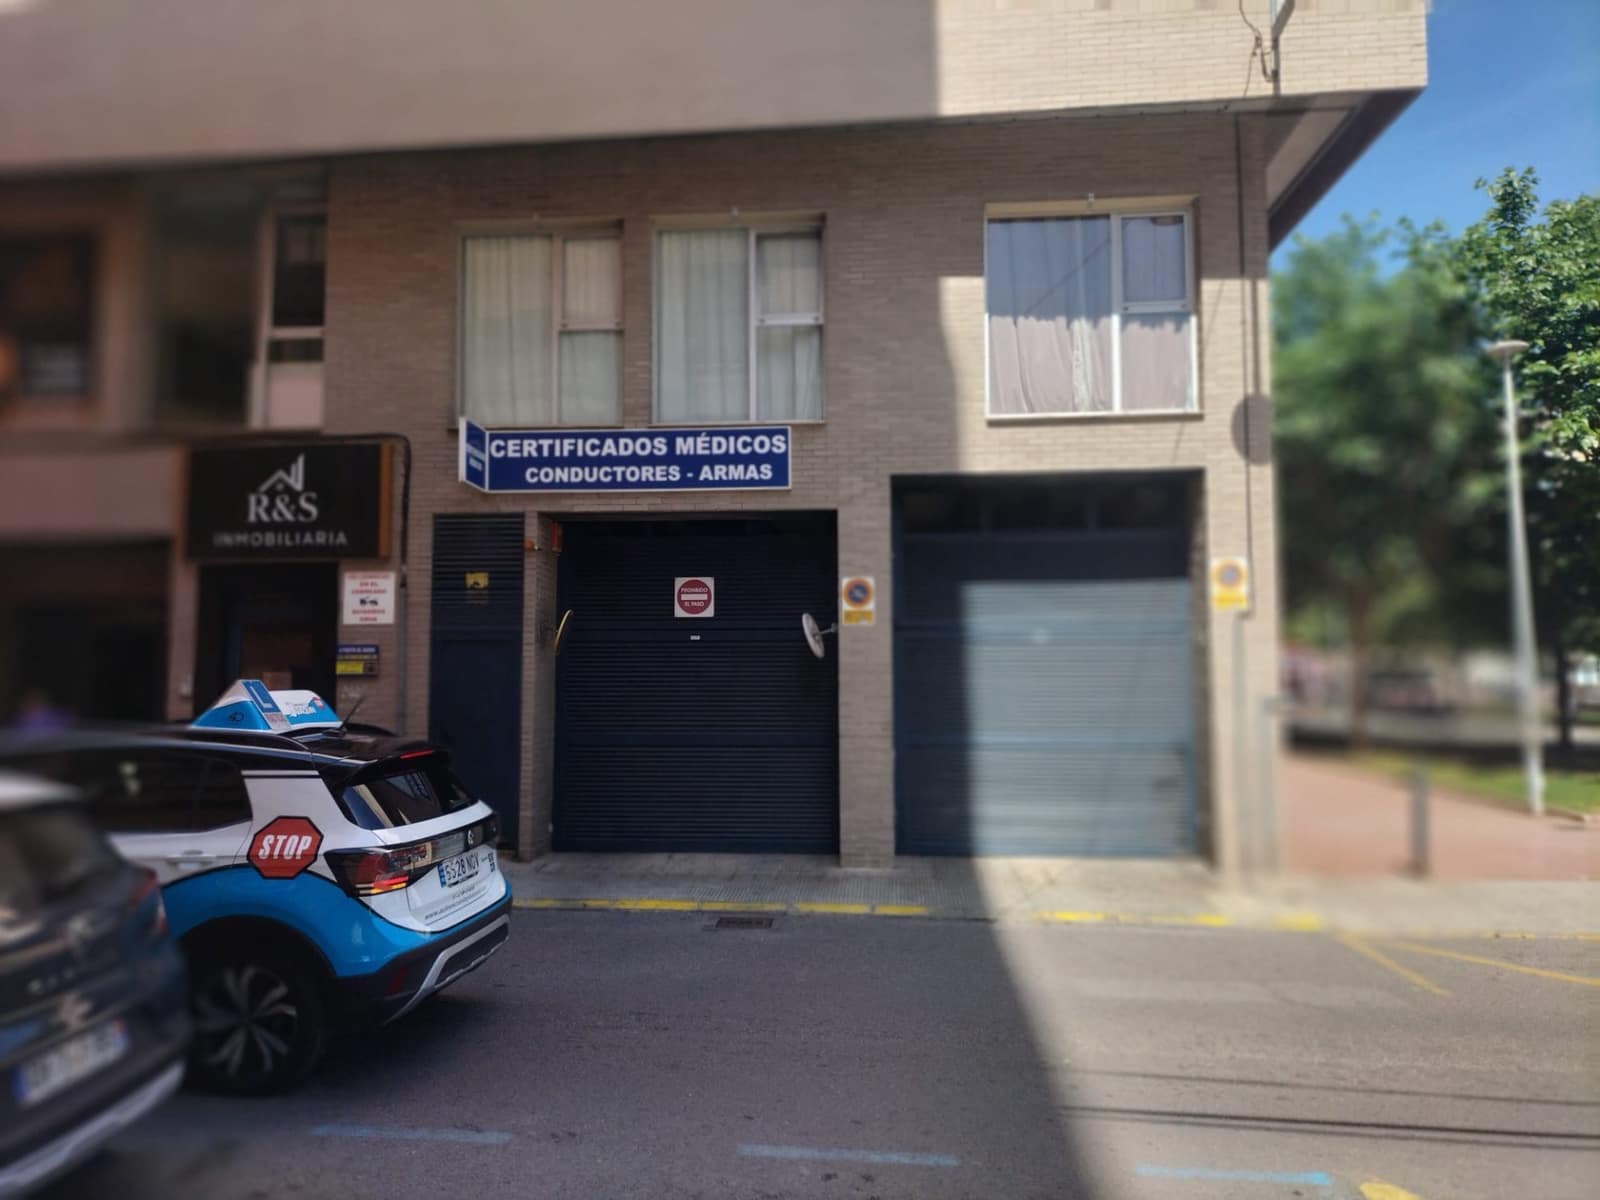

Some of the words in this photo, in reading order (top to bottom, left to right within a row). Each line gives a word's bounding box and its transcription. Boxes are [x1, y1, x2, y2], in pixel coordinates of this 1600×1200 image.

[490, 437, 668, 458] CERTIFICADOS
[675, 431, 787, 455] MÉDICOS
[525, 466, 681, 483] CONDUCTORES
[699, 463, 773, 481] ARMAS
[247, 491, 319, 523] R&S
[213, 530, 349, 547] INMOBILIARIA
[258, 834, 313, 860] STOP
